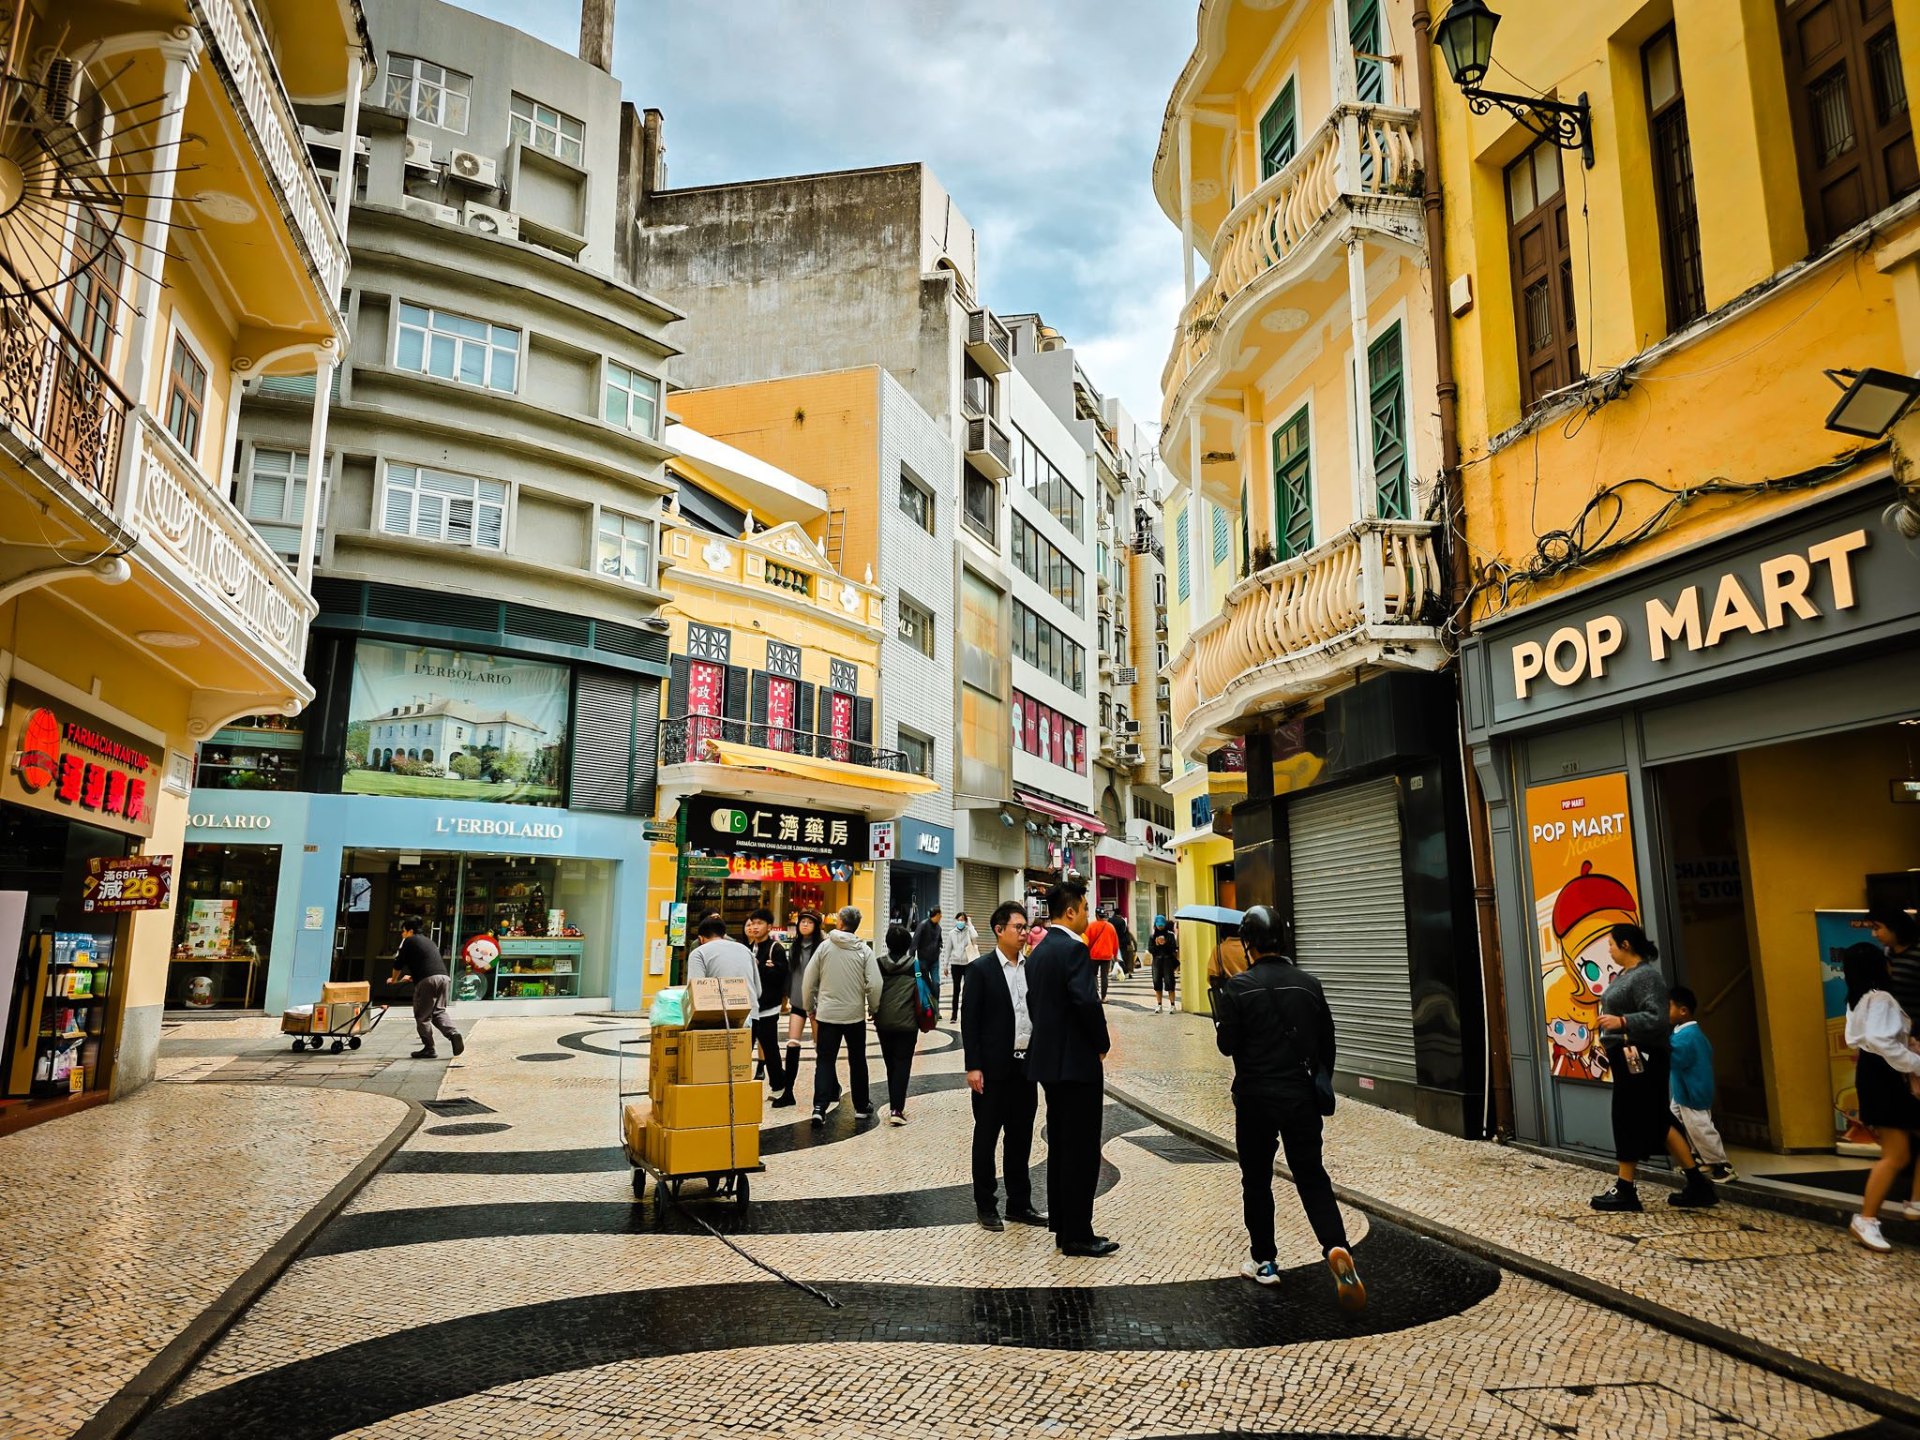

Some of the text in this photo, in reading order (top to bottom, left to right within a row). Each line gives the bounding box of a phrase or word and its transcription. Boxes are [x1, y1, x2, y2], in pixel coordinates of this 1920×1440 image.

[1512, 529, 1871, 699] POP MART
[414, 664, 512, 685] L'ERBOLARIO
[1562, 798, 1584, 809] POP MART
[436, 816, 563, 839] L'ERBOLARIO
[752, 810, 848, 846] 仁濟藥房
[1533, 813, 1625, 843] POP MART
[920, 832, 940, 854] MLB
